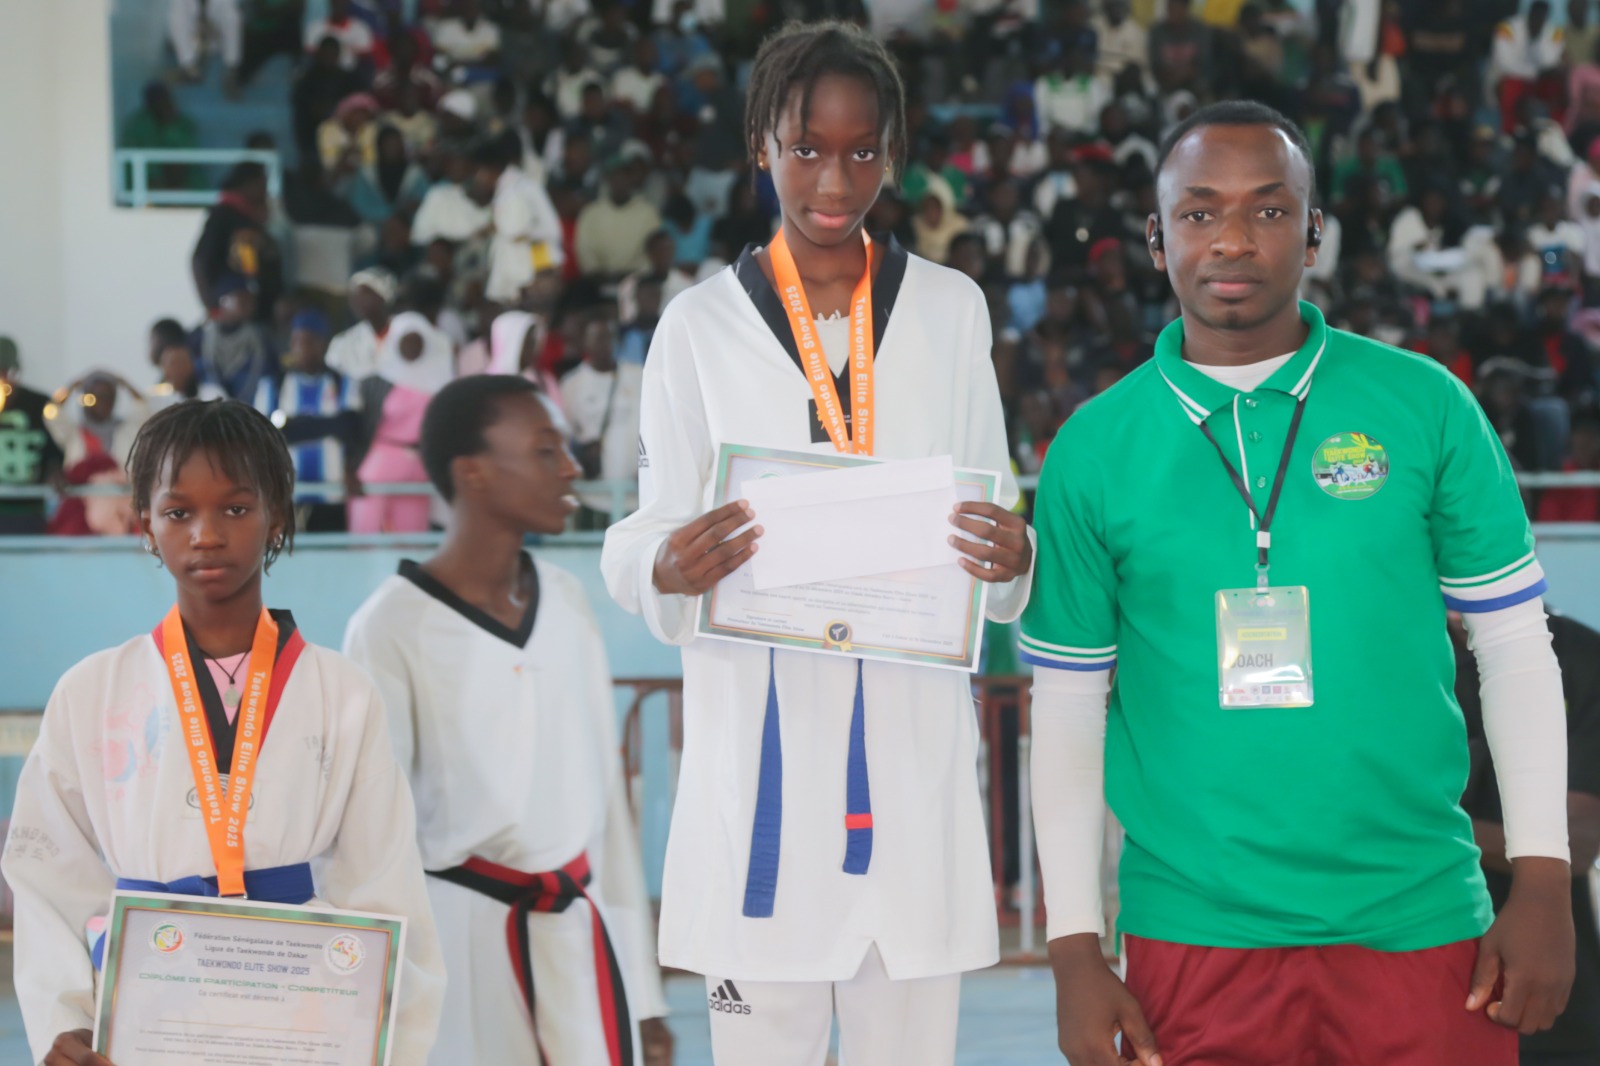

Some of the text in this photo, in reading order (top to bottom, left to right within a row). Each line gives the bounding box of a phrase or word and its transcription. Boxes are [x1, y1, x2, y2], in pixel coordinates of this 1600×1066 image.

[785, 285, 804, 313] 2025
[798, 316, 815, 349] Show
[855, 297, 867, 369] Taekwondo
[810, 352, 825, 381] Elite
[857, 373, 868, 404] Elite
[858, 408, 869, 445] Show
[1231, 653, 1274, 669] OACH
[171, 652, 222, 825] Taekwondo Elite Show 2025
[226, 672, 266, 848] Taekwondo Elite Show 2025
[197, 958, 311, 976] TAEKWONDO ELITE SHOW 2025
